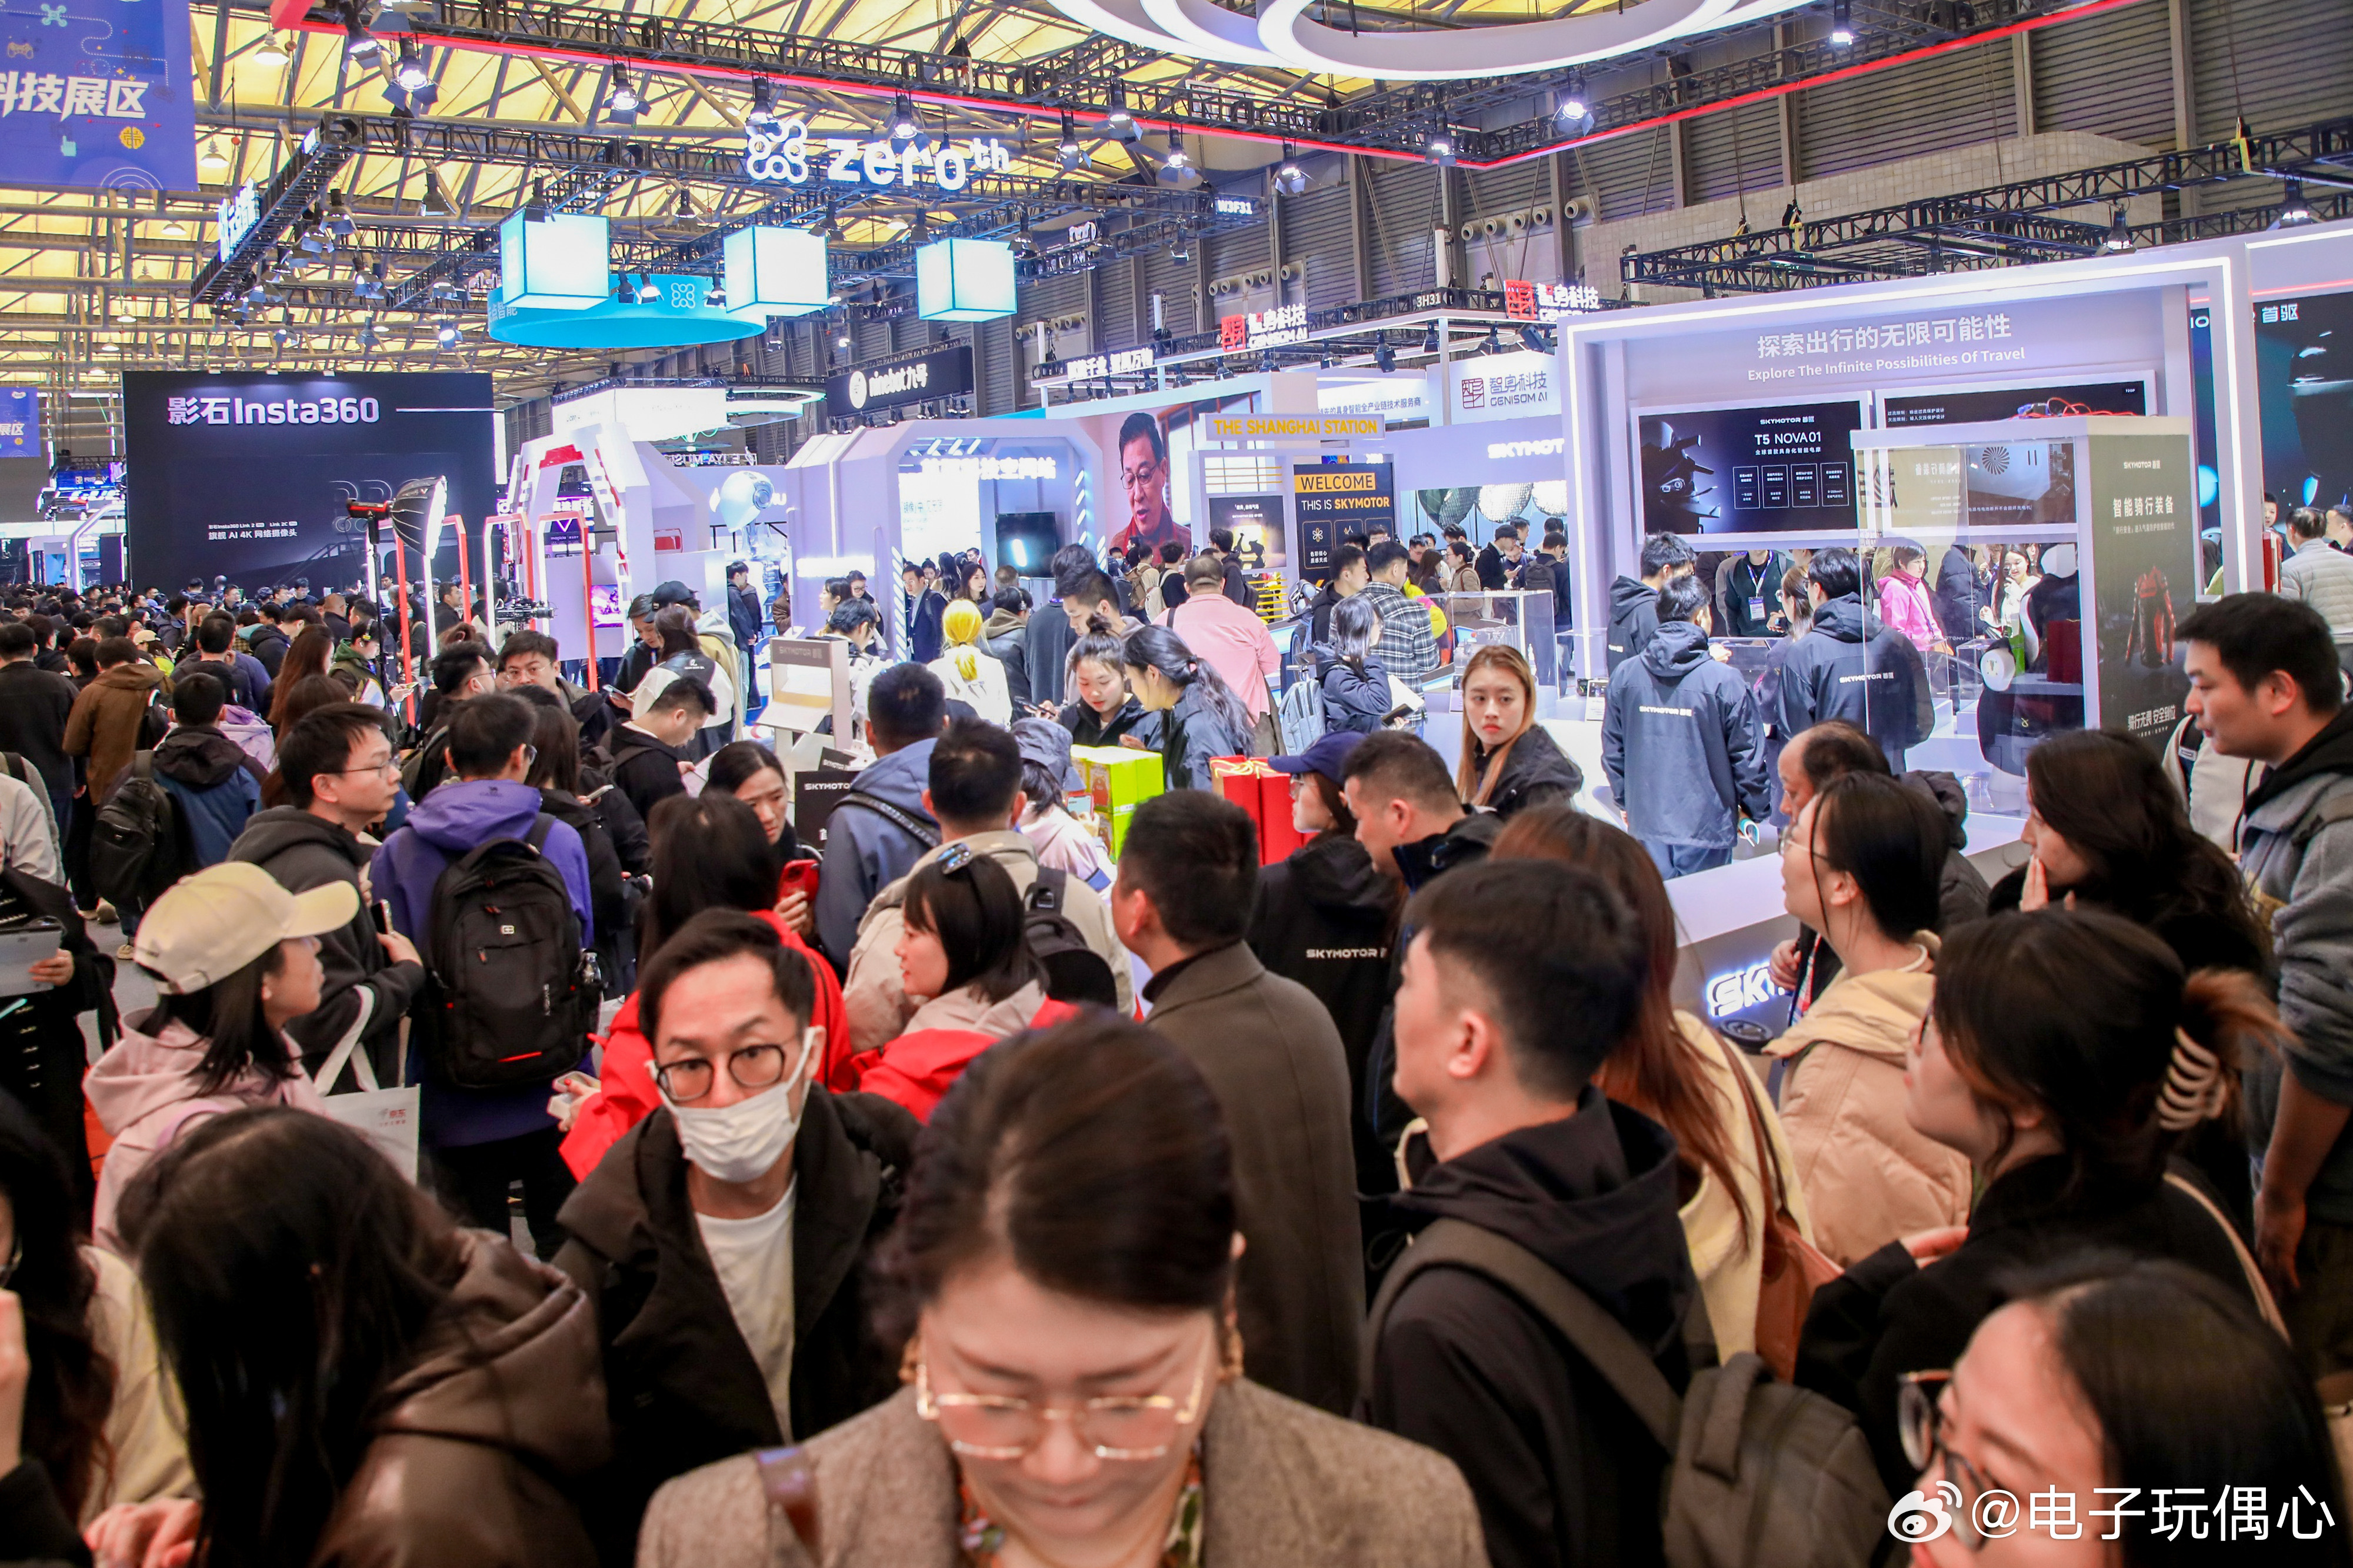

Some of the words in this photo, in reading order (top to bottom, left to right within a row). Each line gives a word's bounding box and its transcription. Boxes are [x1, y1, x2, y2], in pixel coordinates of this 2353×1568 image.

[1417, 292, 1441, 308] 3H31
[1538, 283, 1600, 309] 智身科技
[1248, 302, 1307, 334] 智身科技
[2262, 303, 2298, 323] 首驱
[1757, 313, 2011, 359] 探索出行的无限可能性
[1748, 368, 1795, 382] Explore
[1798, 363, 1822, 376] The
[1825, 359, 1873, 375] Infinite
[1876, 352, 1958, 370] Possibilities
[1961, 351, 1978, 363] Of
[1980, 347, 2025, 362] Travel
[1489, 371, 1547, 395] 智身科技
[1490, 393, 1535, 406] GENISOM
[1214, 419, 1242, 435] THE
[1247, 419, 1320, 435] SHANGHAI
[1325, 419, 1378, 434] STATION
[1754, 434, 1770, 445] T5
[1301, 475, 1372, 489] WELCOME
[1301, 501, 1321, 511] THIS
[1324, 499, 1332, 510] IS
[1334, 497, 1390, 509] SKYMOTOR
[2113, 495, 2173, 518] 智能骑行装备
[209, 531, 226, 540] 旗舰
[255, 529, 297, 538] 网络摄像头
[779, 646, 811, 656] SKYMOTOR
[1306, 949, 1378, 958] SKYMOTOR
